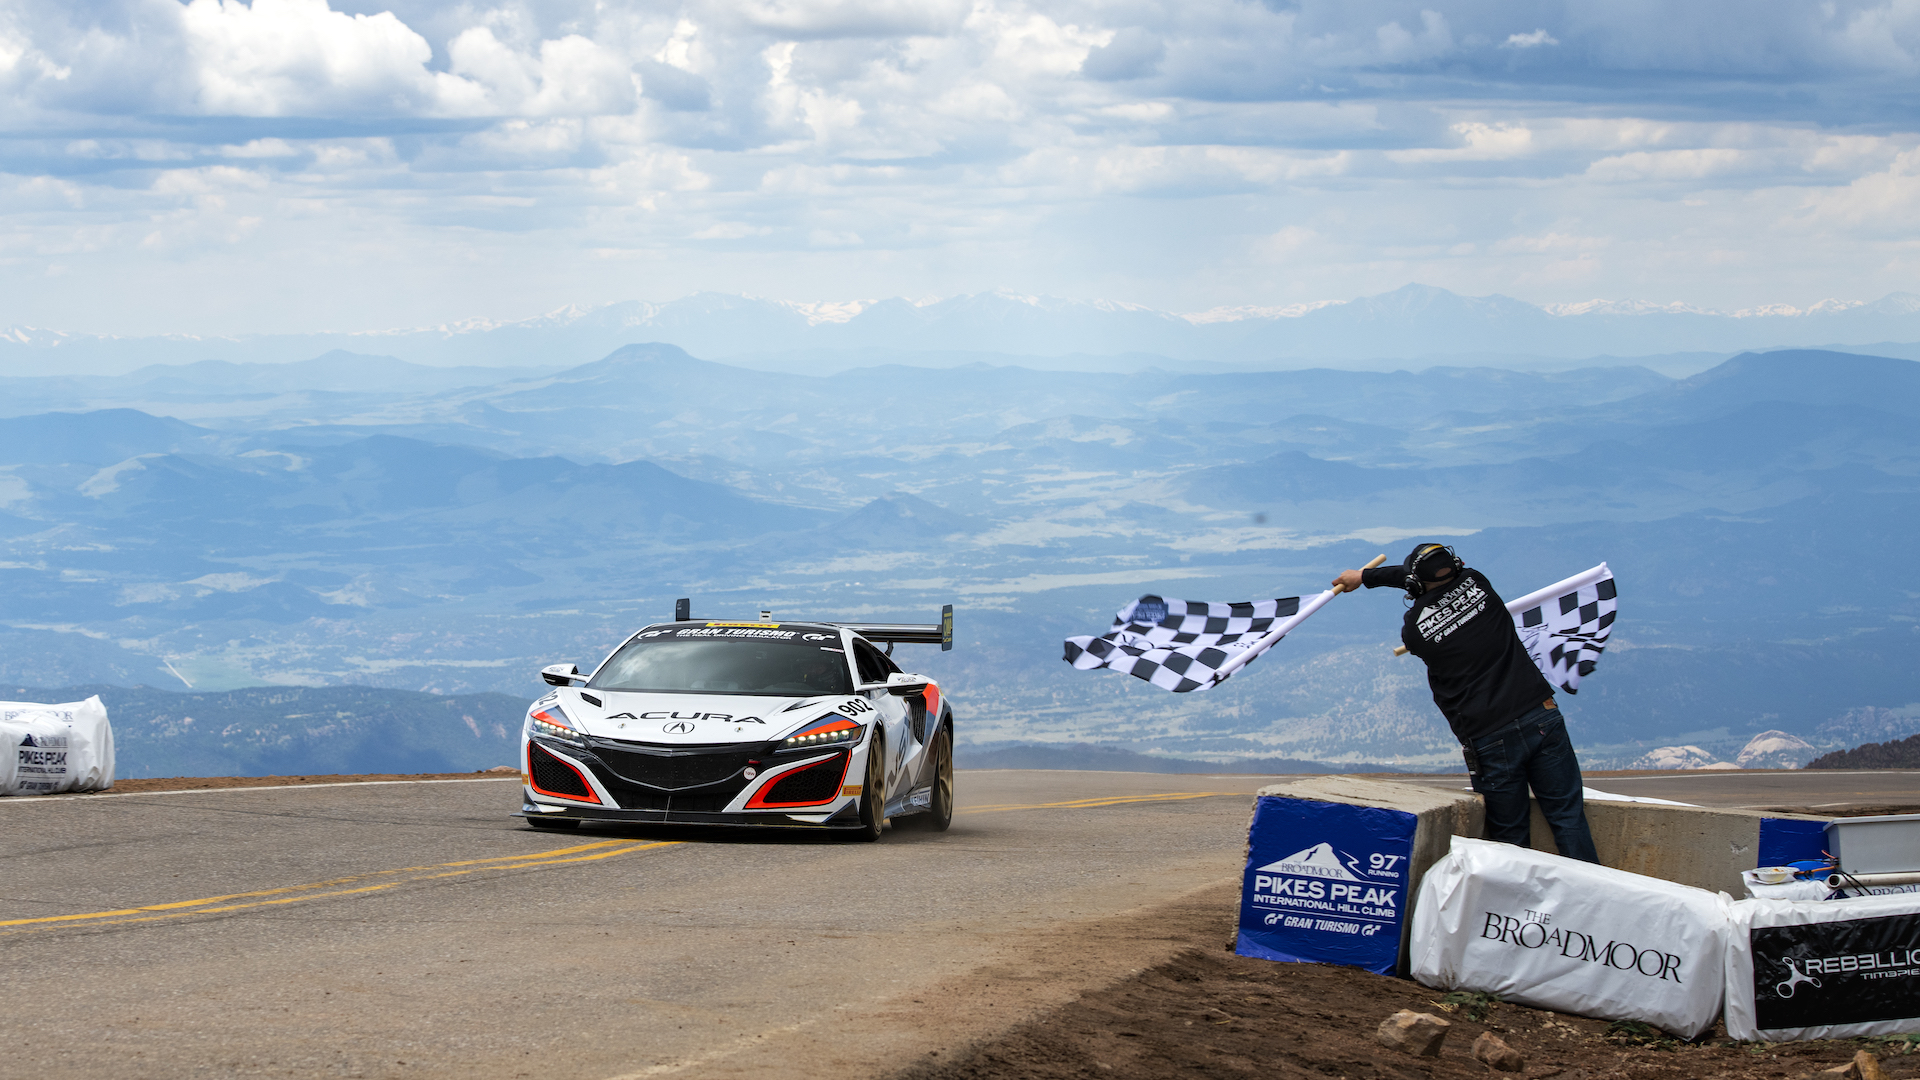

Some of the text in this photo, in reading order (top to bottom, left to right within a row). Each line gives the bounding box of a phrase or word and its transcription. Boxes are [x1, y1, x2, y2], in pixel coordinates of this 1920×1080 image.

[1417, 583, 1482, 634] PIKES PEAK
[1422, 610, 1462, 638] INTERNATIONAL
[1443, 623, 1458, 636] GRAN
[1456, 608, 1478, 626] TURISMO
[676, 628, 724, 636] GRAN
[725, 628, 797, 638] TURISMO
[838, 698, 874, 717] 902
[605, 711, 767, 725] ACURA
[19, 750, 67, 766] PIKES PEAK
[1281, 862, 1344, 879] BROADMOOR
[1367, 868, 1400, 879] RUNNING
[1254, 874, 1397, 908] PIKES PEAK
[1253, 893, 1396, 918] INTERNATIONAL HILL CLIMB
[1283, 916, 1314, 930] GRAN
[1314, 919, 1360, 935] TURISMO
[1524, 909, 1552, 925] THE
[1480, 911, 1683, 984] BROADMOOR
